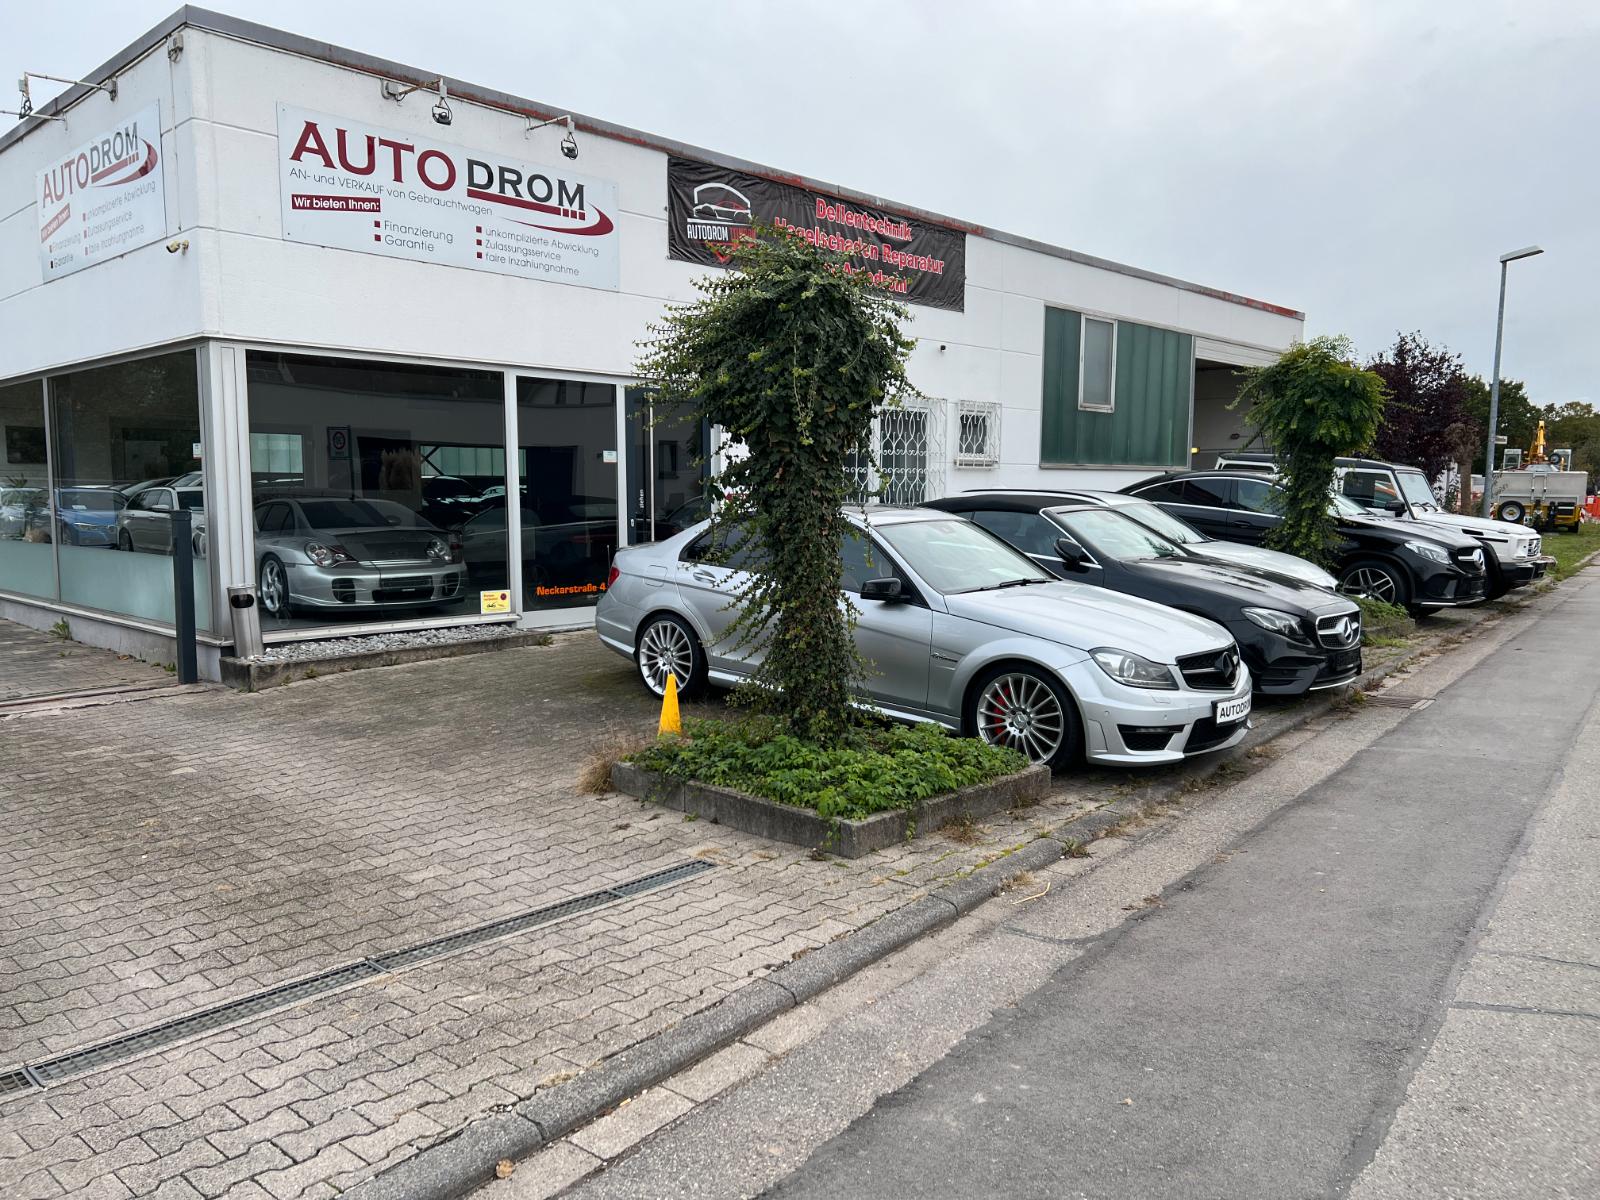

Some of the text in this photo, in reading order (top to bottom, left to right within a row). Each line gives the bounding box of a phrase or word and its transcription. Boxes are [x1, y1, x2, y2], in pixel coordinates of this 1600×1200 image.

[289, 167, 493, 217] AN- und VERKAUF von Gebrauchtwagen
[294, 197, 380, 211] Wir bieten Ihnen:
[815, 197, 913, 242] Dellentechnik
[384, 219, 454, 245] Finanzierung
[384, 234, 435, 252] Garantie
[485, 226, 599, 258] unkomplizierte Abwicklung
[687, 223, 729, 242] AUTODROM
[485, 238, 562, 261] Zulassungsservice
[881, 242, 945, 275] Reparatur
[536, 583, 598, 597] Neckarstraße
